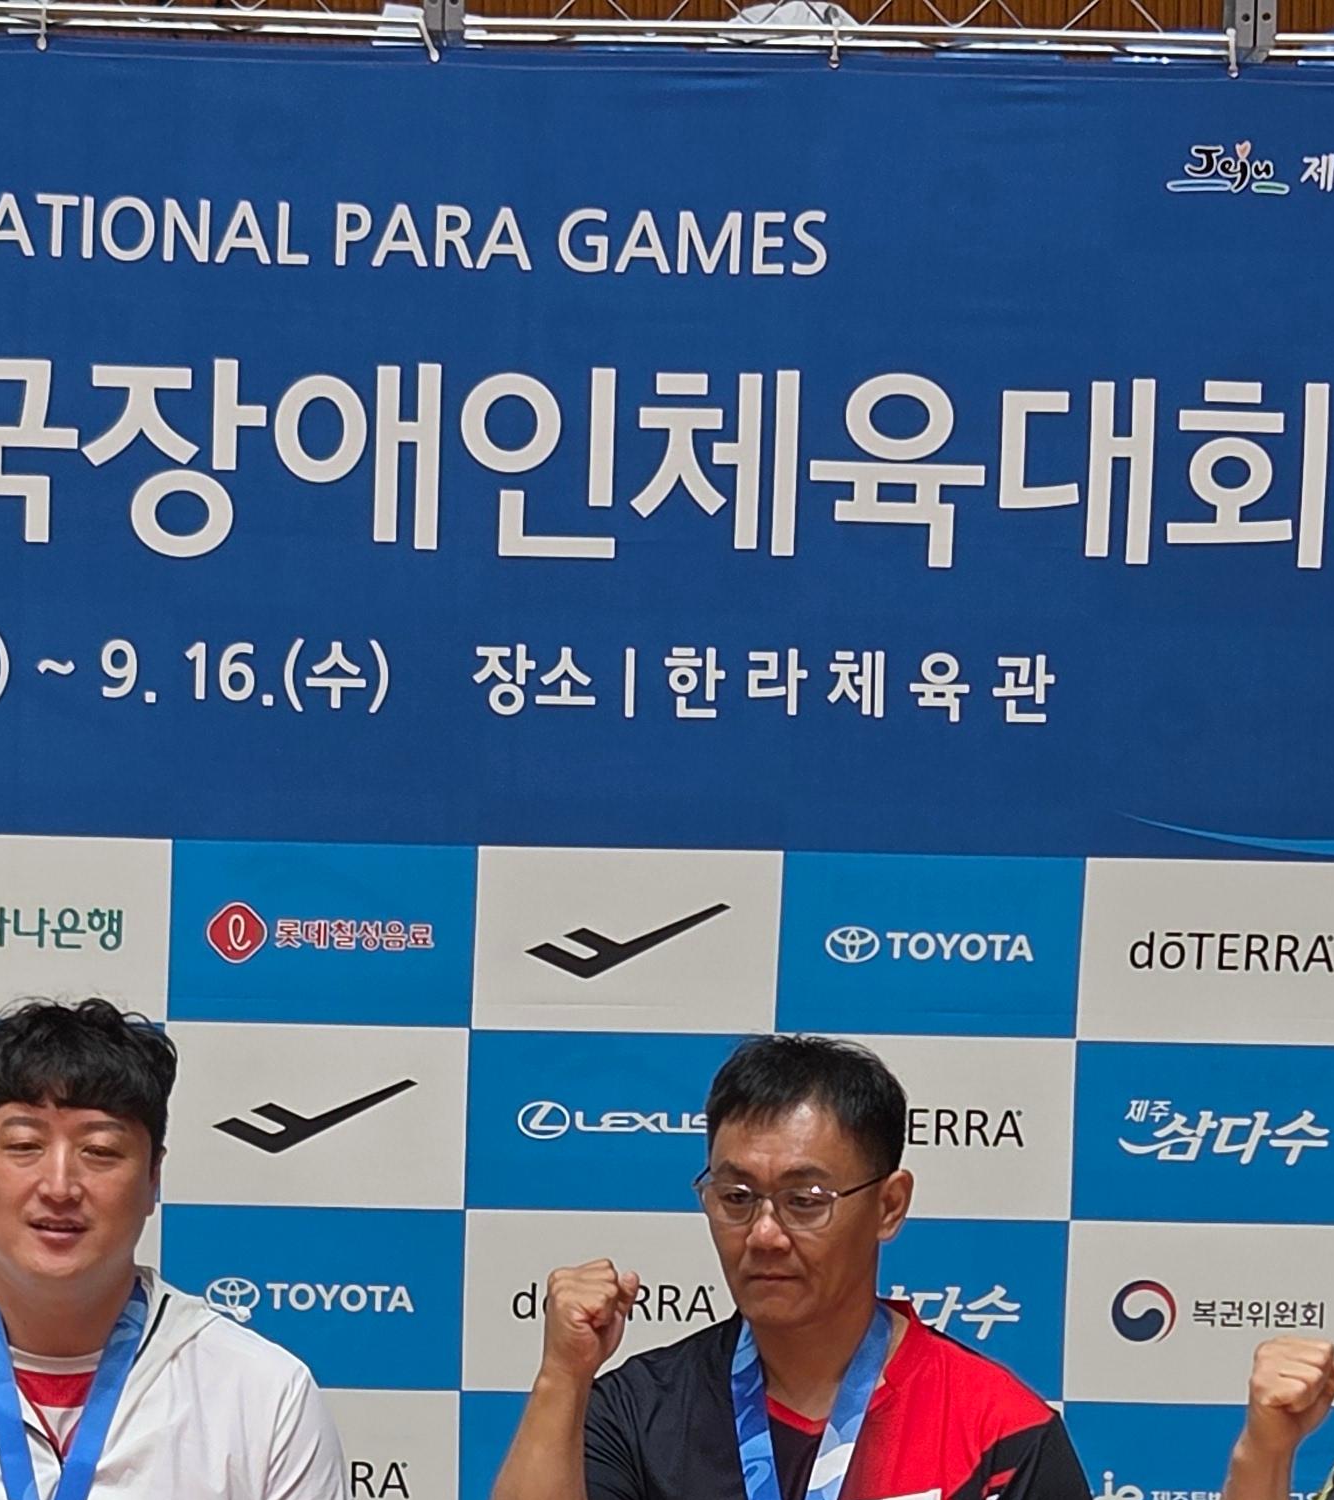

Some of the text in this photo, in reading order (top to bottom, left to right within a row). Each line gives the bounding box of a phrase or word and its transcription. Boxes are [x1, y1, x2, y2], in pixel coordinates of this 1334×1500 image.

[1184, 141, 1274, 193] Jeju
[333, 203, 533, 271] PARA
[557, 207, 829, 277] GAMES
[99, 638, 157, 704] 9.
[182, 637, 392, 713] 16.(수)
[472, 641, 598, 716] 장소
[275, 919, 435, 951] 롯데칠성음료
[886, 931, 1034, 962] TOYOTA
[1125, 1099, 1171, 1123] 제주
[1119, 1110, 1329, 1166] 삼다수
[266, 1282, 414, 1313] TOYOTA
[1192, 1300, 1325, 1330] 복권위원회
